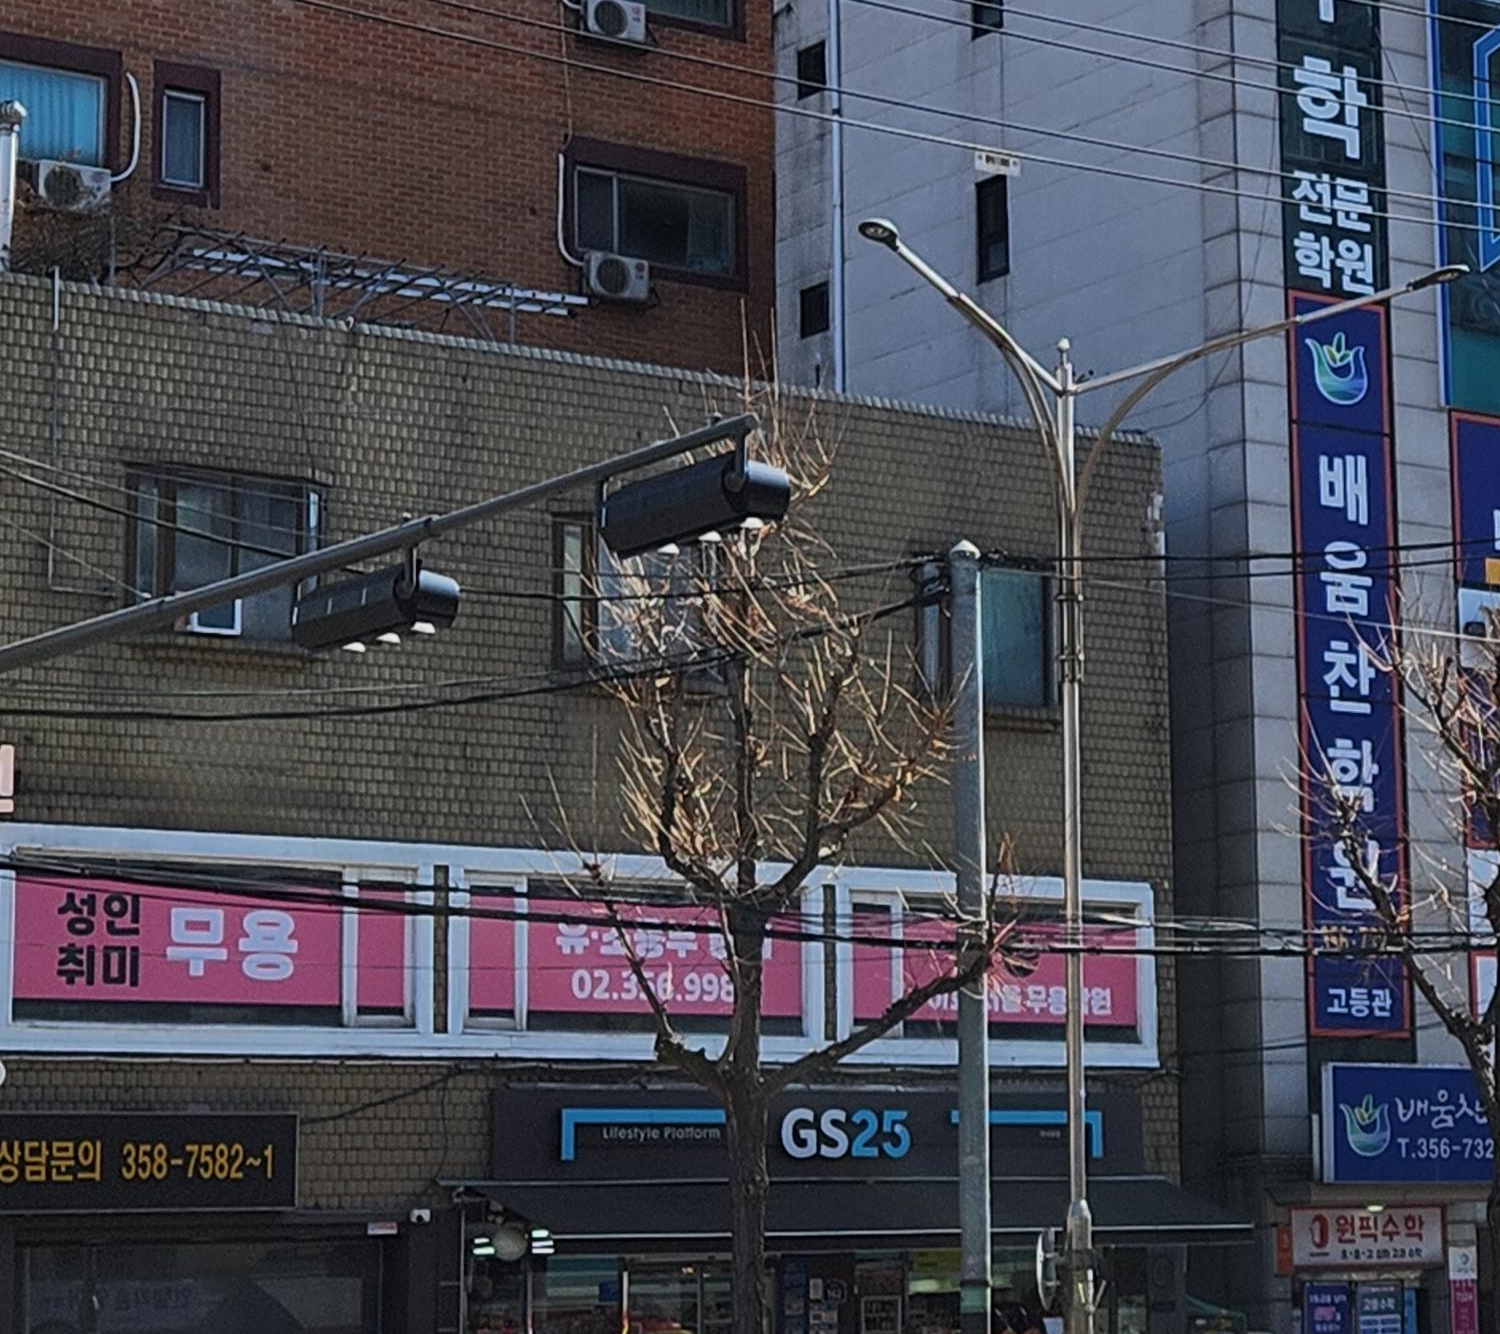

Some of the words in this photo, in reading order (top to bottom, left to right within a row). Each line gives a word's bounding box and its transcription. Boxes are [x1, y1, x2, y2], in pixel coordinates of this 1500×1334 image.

[1291, 170, 1373, 231] 전문
[1293, 233, 1375, 294] 학원
[1318, 453, 1380, 911] 배움찬학원
[57, 891, 141, 937] 성인
[166, 907, 298, 981] 무용
[57, 943, 140, 988] 취미
[571, 969, 735, 1004] 02.356.998
[1027, 986, 1112, 1016] 무용원
[1326, 986, 1393, 1018] 고등관
[603, 1126, 660, 1142] Lifestyle
[663, 1126, 721, 1140] Platform
[780, 1107, 912, 1160] GS25
[1397, 1136, 1495, 1160] T.356-732
[0, 1139, 102, 1185] 상담문의
[121, 1142, 275, 1180] 358-7582~1
[1335, 1213, 1425, 1244] 원픽수학
